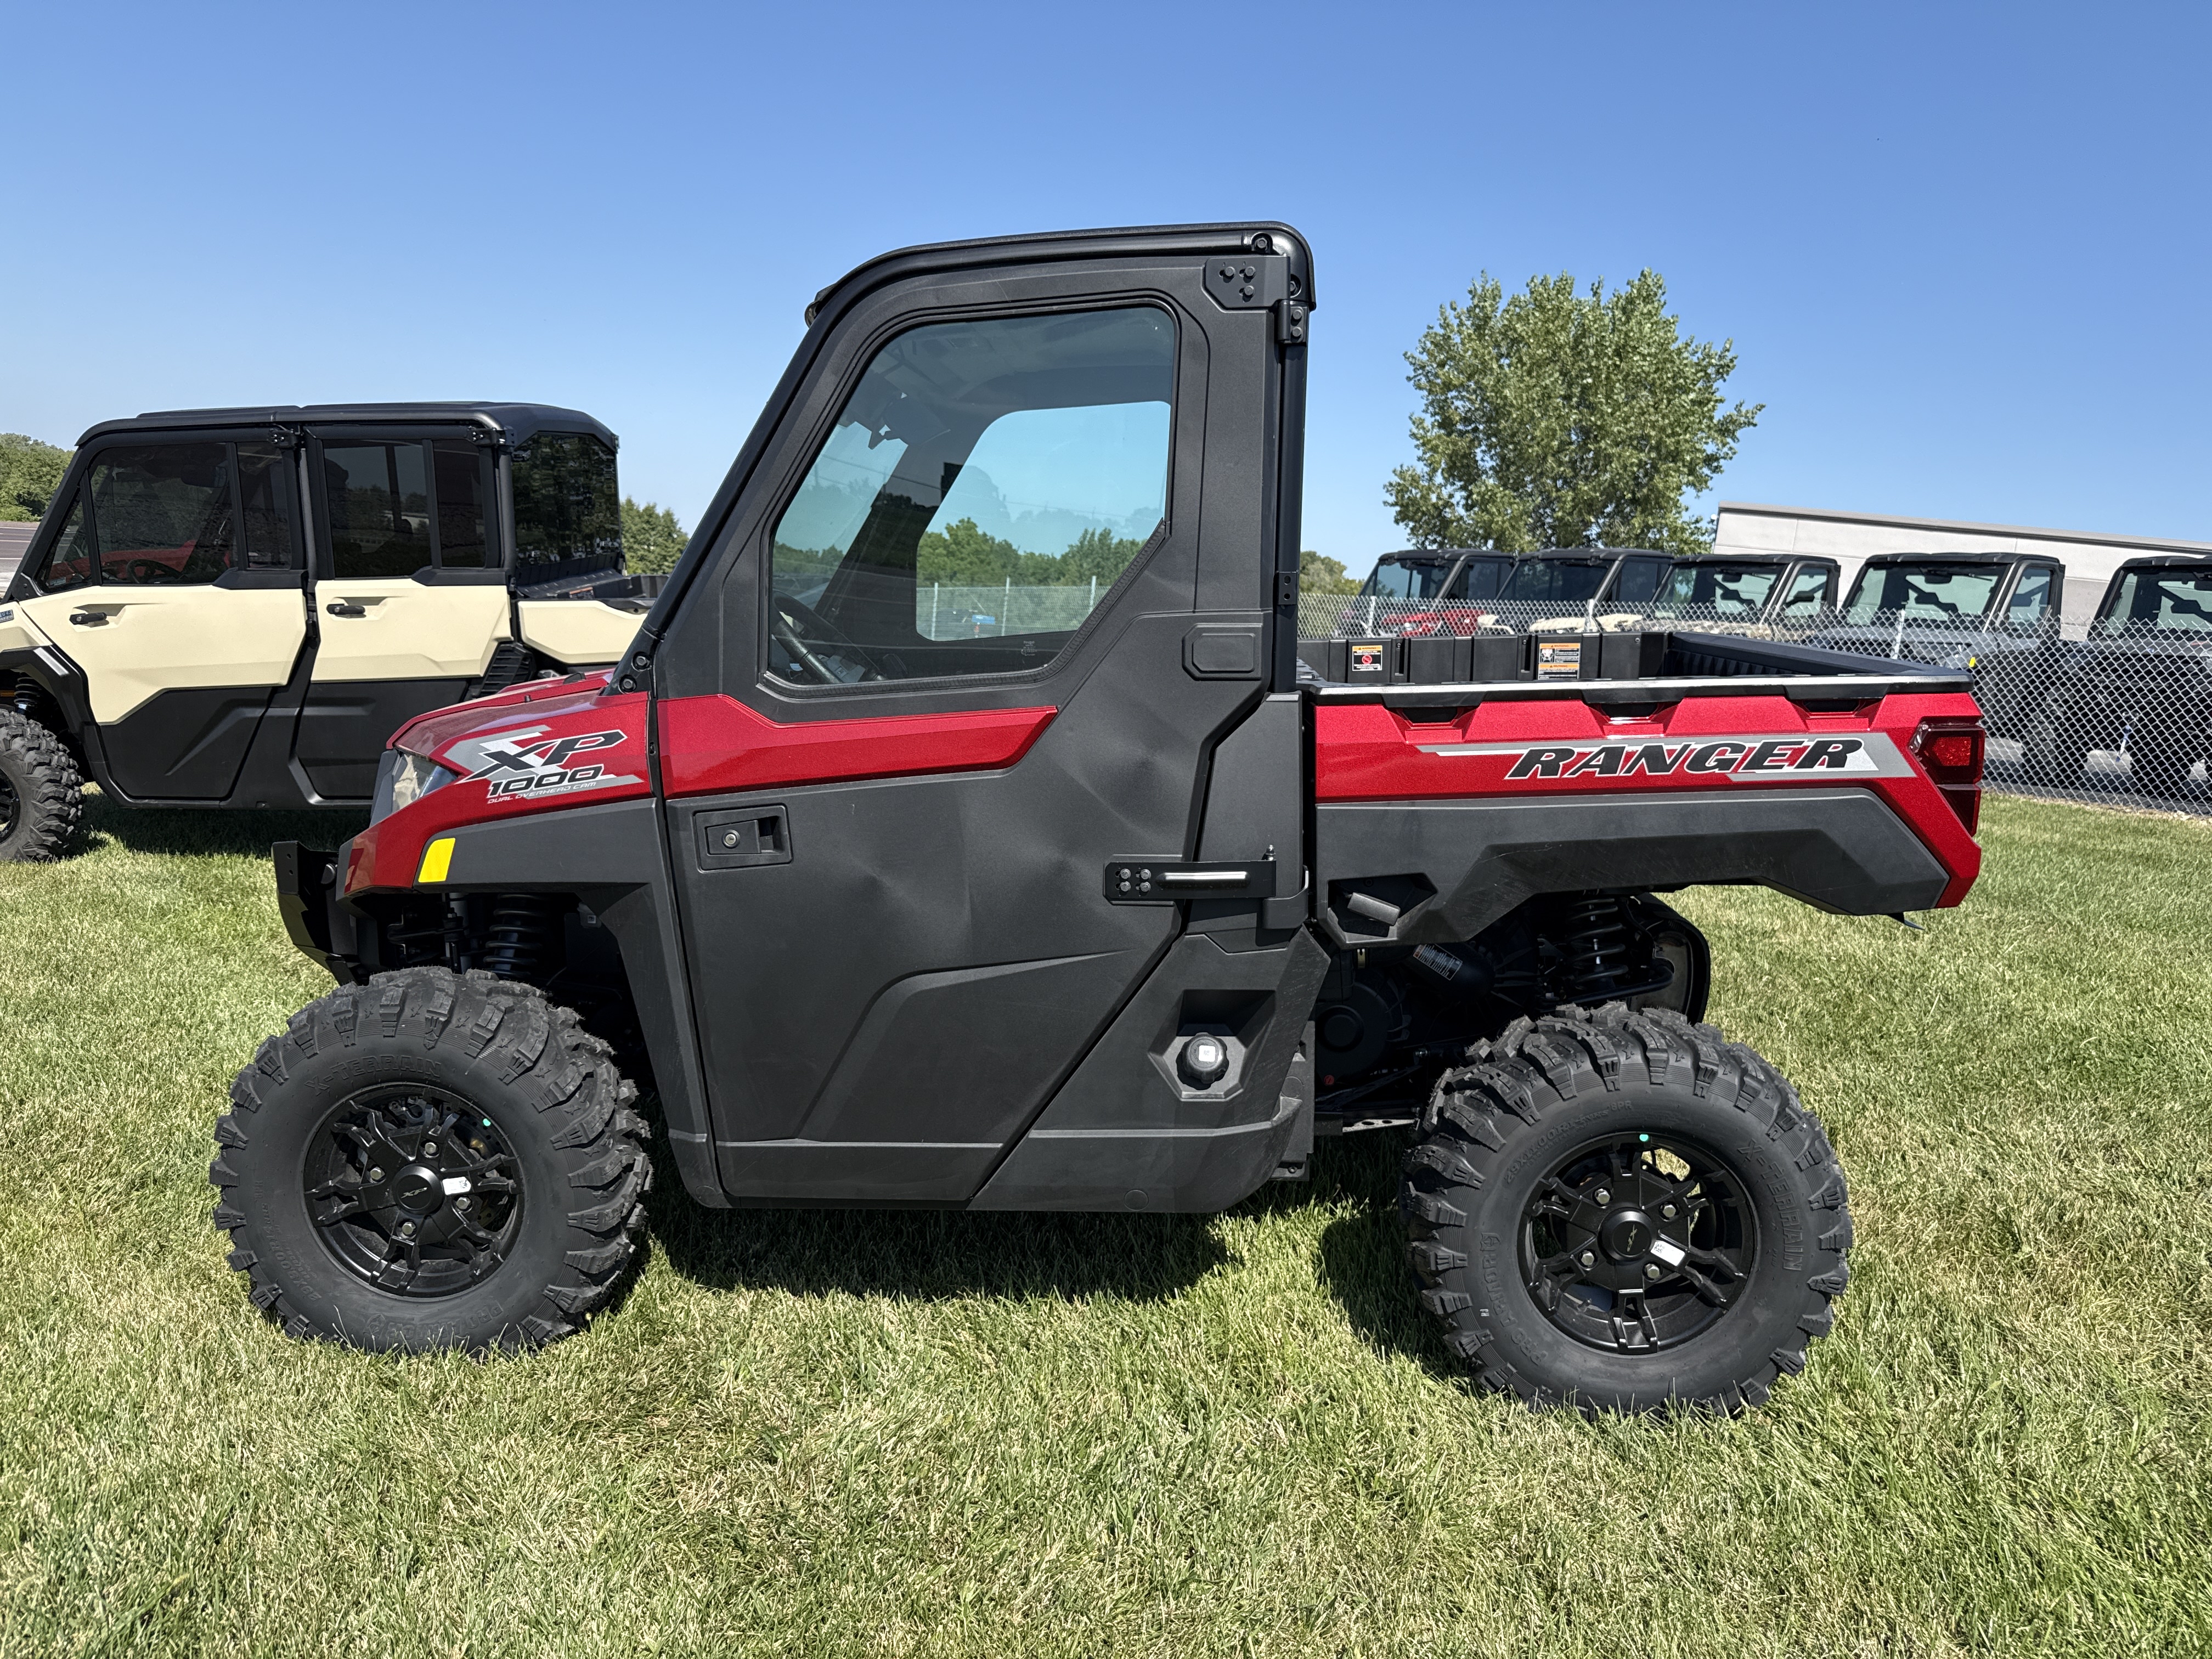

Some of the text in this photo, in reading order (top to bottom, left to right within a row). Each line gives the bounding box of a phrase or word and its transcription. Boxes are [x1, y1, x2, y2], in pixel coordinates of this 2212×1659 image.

[456, 729, 628, 784] XP
[1504, 738, 1864, 780] RANGER
[487, 763, 604, 798] 1000
[487, 782, 596, 804] DUAL OVERHEAD CAM
[304, 1054, 441, 1096] X-TERRAIN
[1611, 1100, 1632, 1111] 8PR
[400, 1187, 427, 1199] XP
[1737, 1138, 1804, 1271] X-TERRAIN
[1627, 1224, 1637, 1252] XP
[1482, 1254, 1548, 1366] PRO ARMOR
